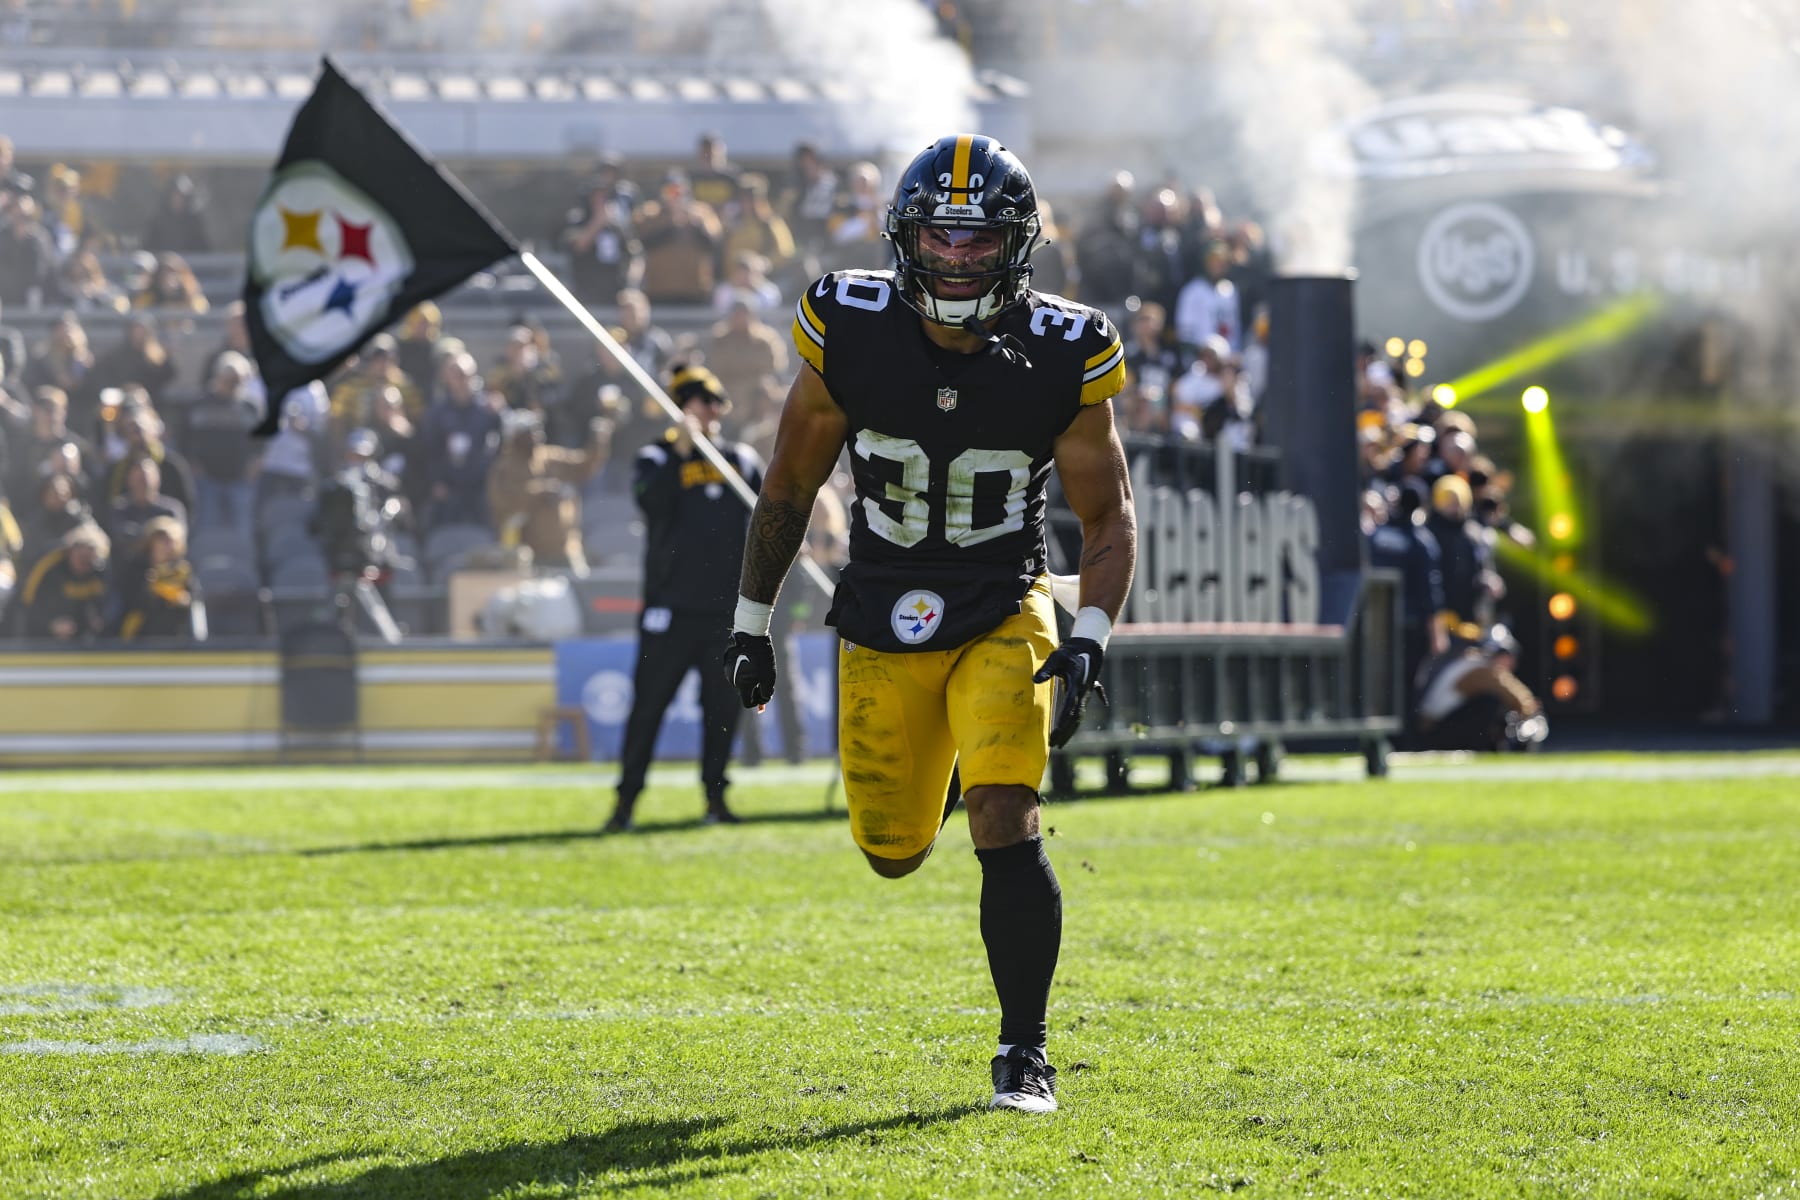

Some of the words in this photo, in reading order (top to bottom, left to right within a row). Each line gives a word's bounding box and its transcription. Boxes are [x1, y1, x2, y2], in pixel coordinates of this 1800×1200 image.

[945, 206, 973, 216] Steelers
[854, 428, 1034, 548] 30
[1128, 430, 1321, 624] teelers
